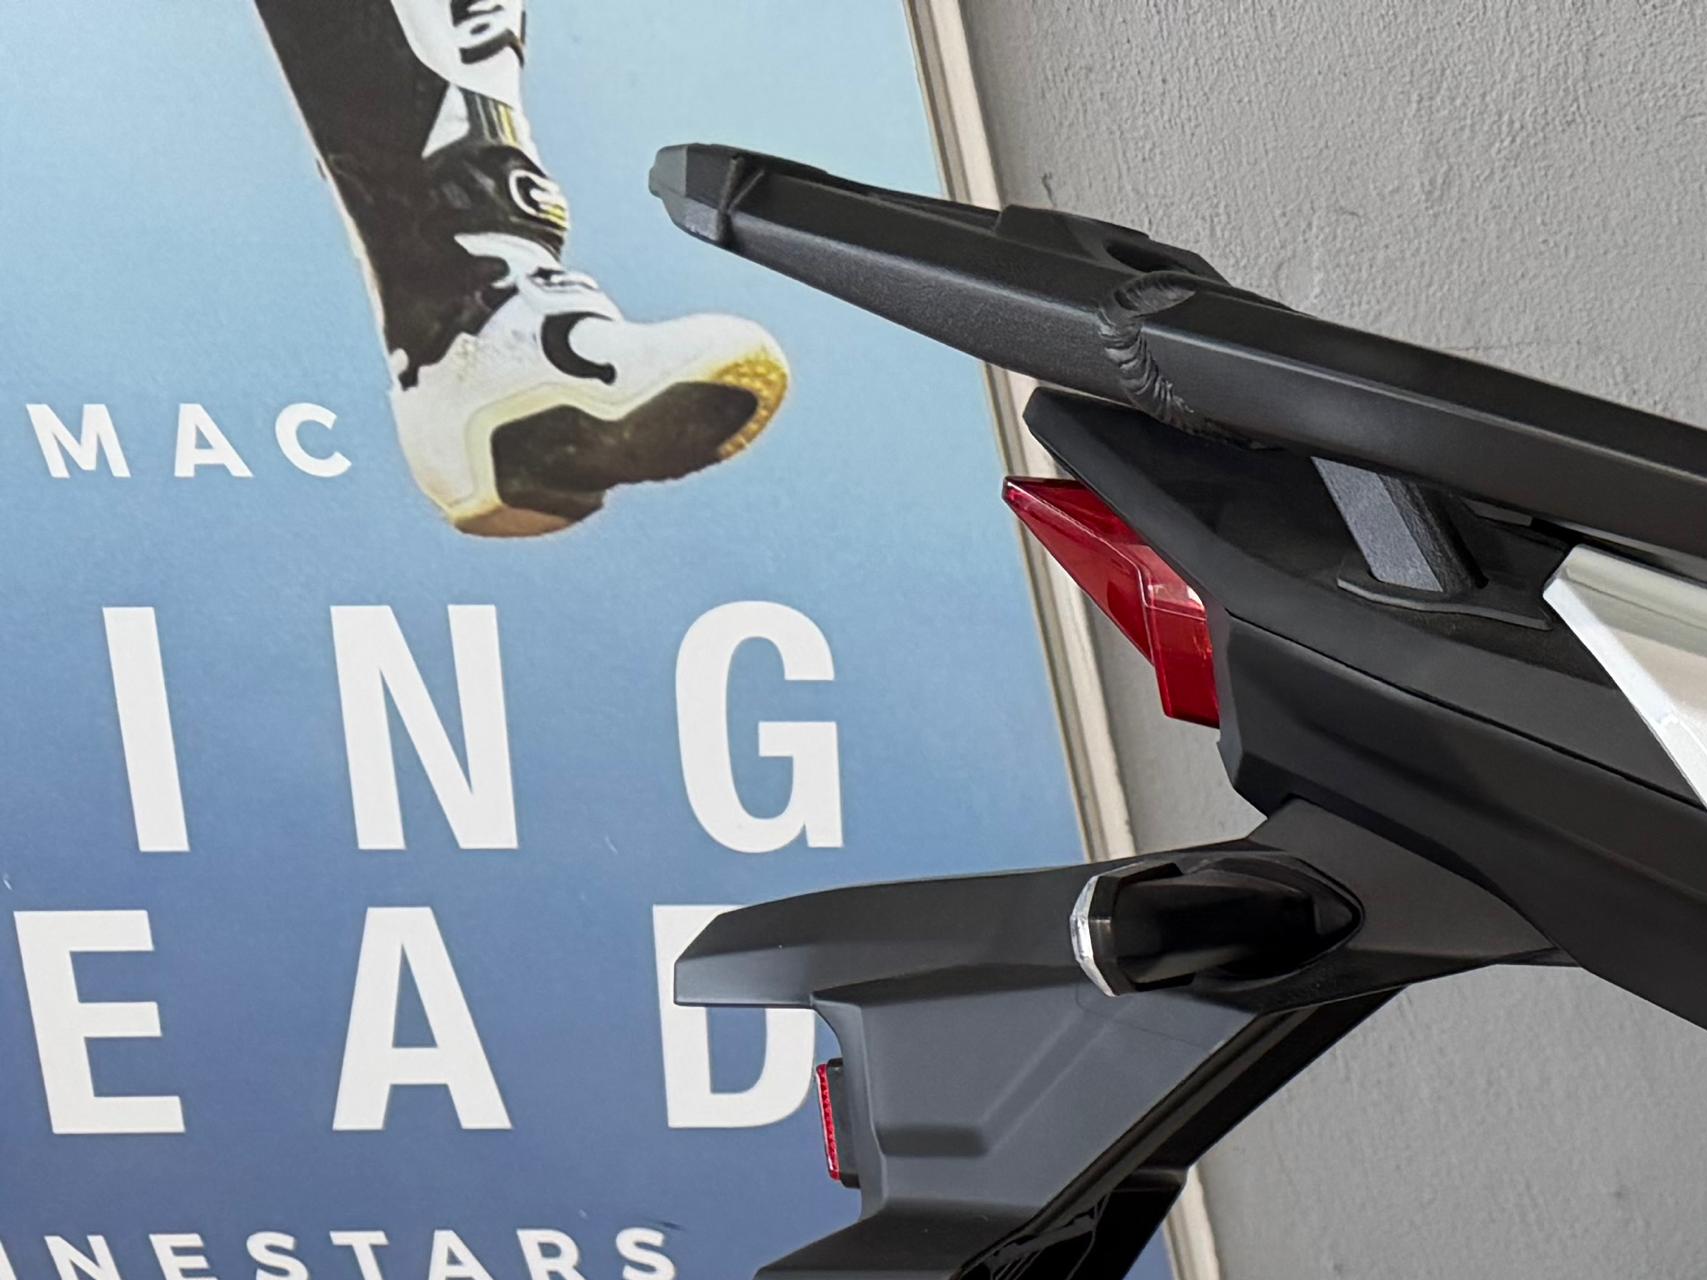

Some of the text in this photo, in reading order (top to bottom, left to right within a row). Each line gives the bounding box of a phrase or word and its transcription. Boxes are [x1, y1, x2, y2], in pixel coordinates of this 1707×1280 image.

[25, 402, 352, 479] MAC
[103, 600, 846, 854] ING
[13, 905, 816, 1134] EAD
